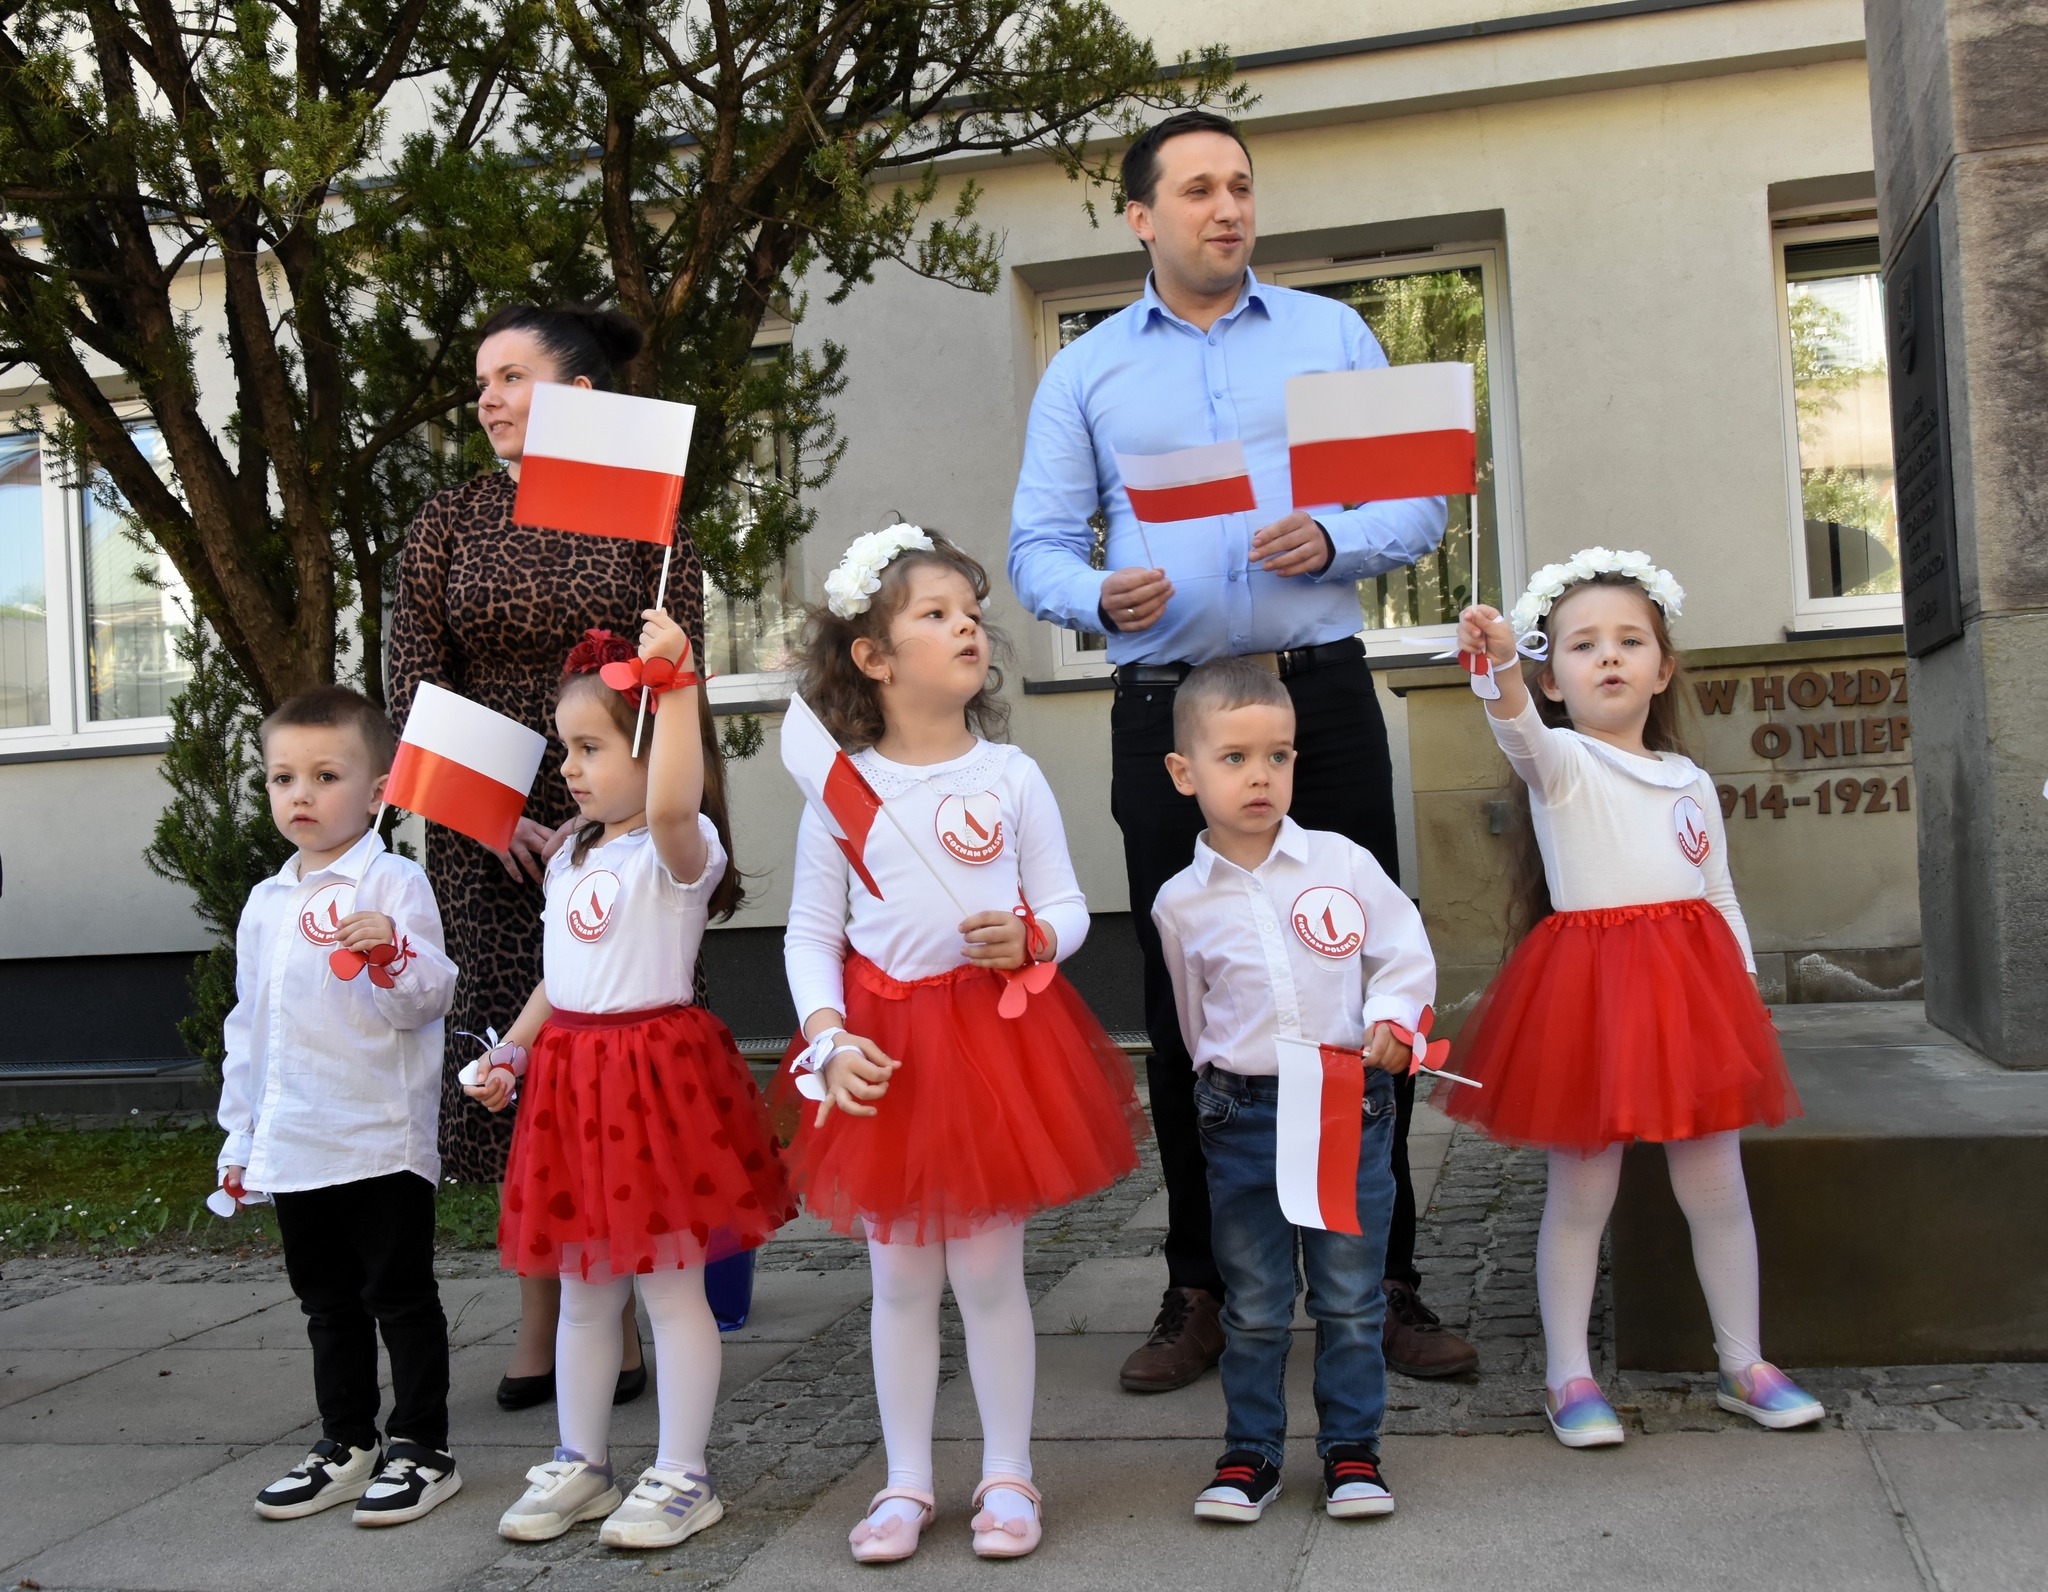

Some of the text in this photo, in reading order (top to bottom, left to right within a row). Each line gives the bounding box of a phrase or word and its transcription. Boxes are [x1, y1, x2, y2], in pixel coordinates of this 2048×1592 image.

[1695, 667, 1908, 715] W HOŁDZ
[1752, 723, 1791, 759] O
[944, 834, 981, 857] KOCHAM
[305, 914, 325, 939] KOCHAM
[571, 912, 594, 936] KOCHAM
[1297, 916, 1324, 950] KOCHAM
